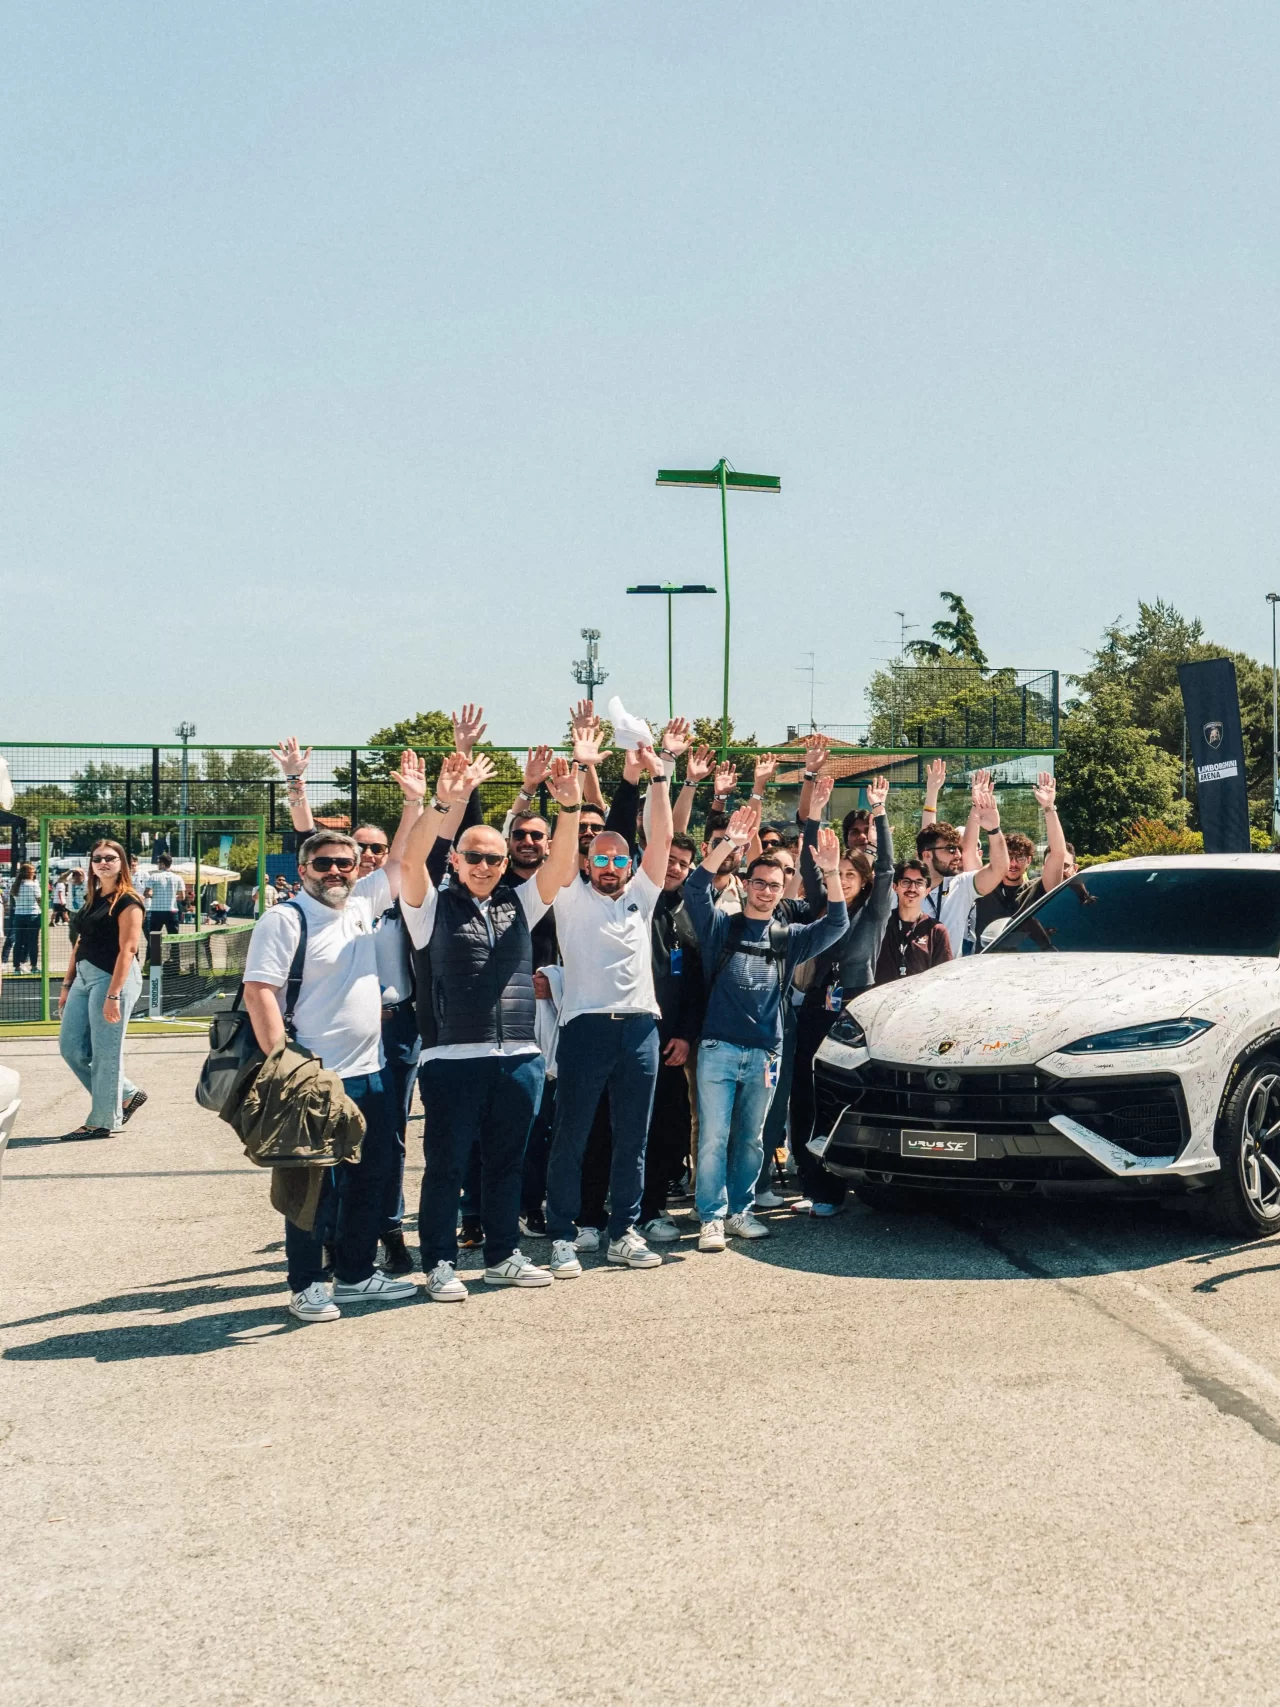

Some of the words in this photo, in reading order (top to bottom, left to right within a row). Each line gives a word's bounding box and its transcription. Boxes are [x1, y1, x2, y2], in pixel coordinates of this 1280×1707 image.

[1197, 760, 1237, 774] LAMBORGHINI
[1200, 771, 1221, 781] ARENA
[908, 1140, 945, 1148] URUS
[946, 1141, 968, 1151] SE
